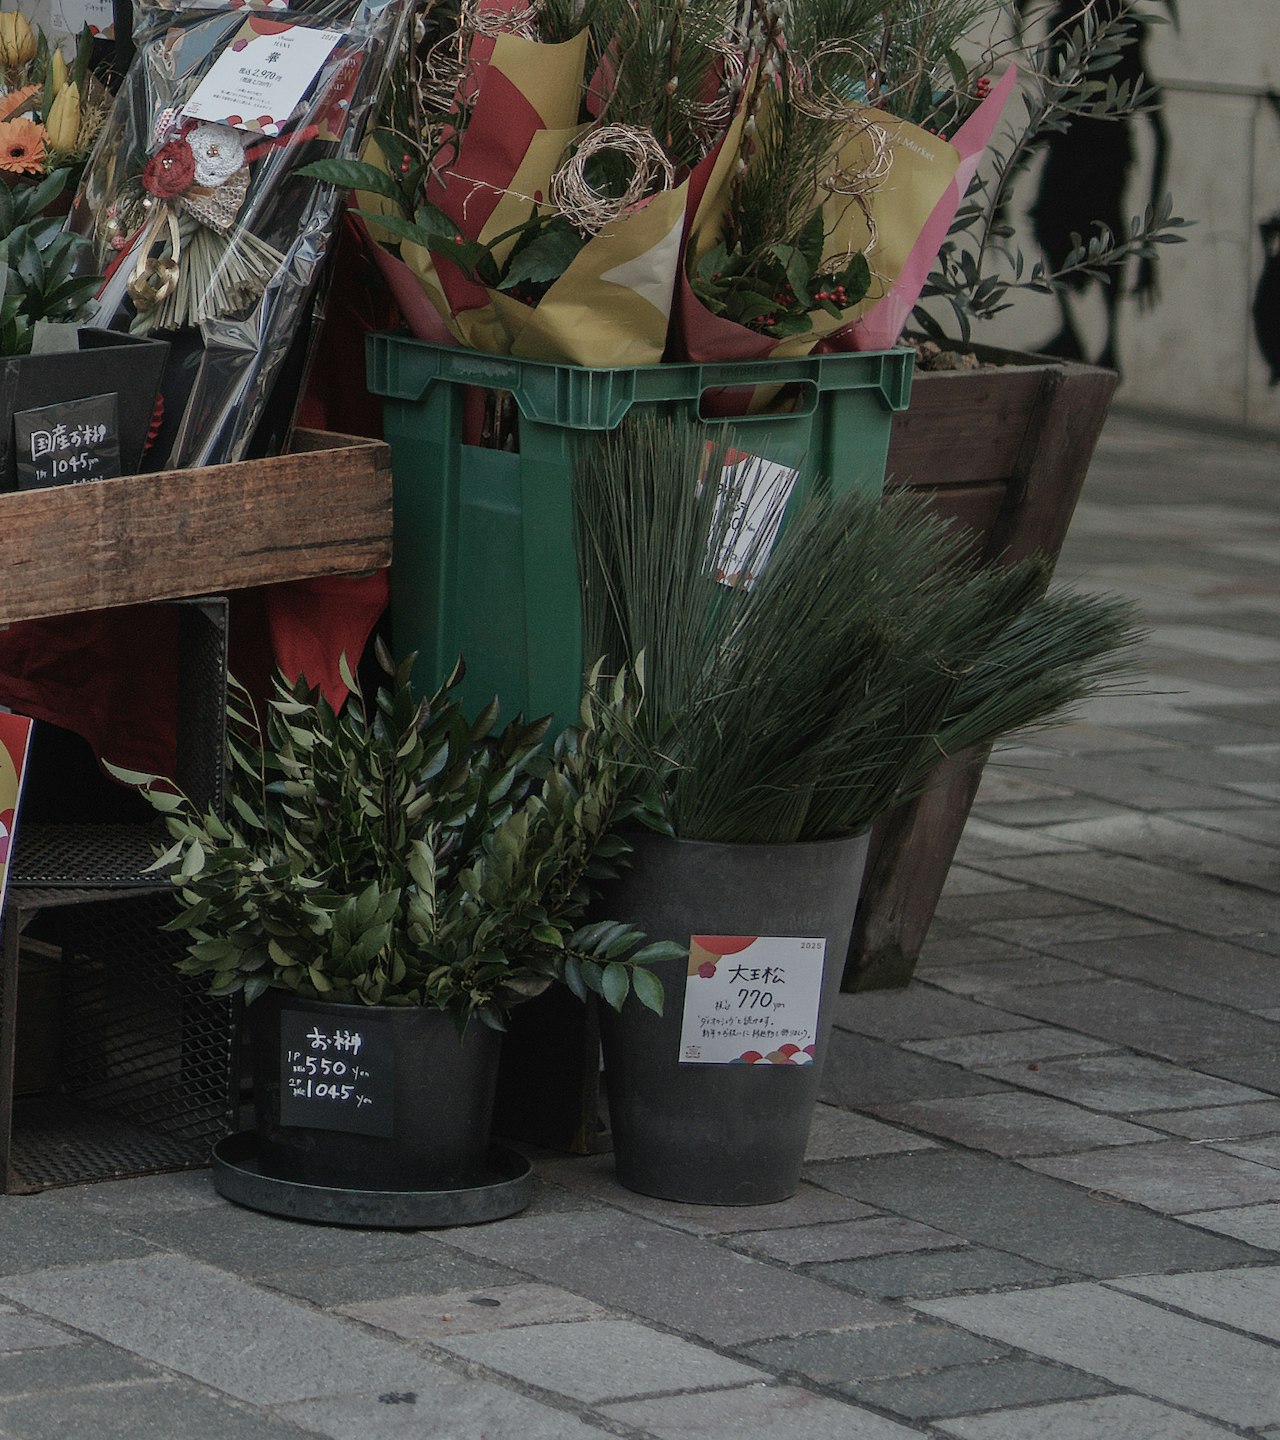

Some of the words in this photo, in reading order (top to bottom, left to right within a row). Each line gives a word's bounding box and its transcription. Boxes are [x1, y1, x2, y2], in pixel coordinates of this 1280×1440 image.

[51, 452, 89, 478] 1045
[800, 942, 823, 950] 2025
[728, 964, 785, 984] 大王松
[737, 988, 773, 1009] 770
[305, 1055, 347, 1075] 550
[307, 1079, 355, 1100] 1045
